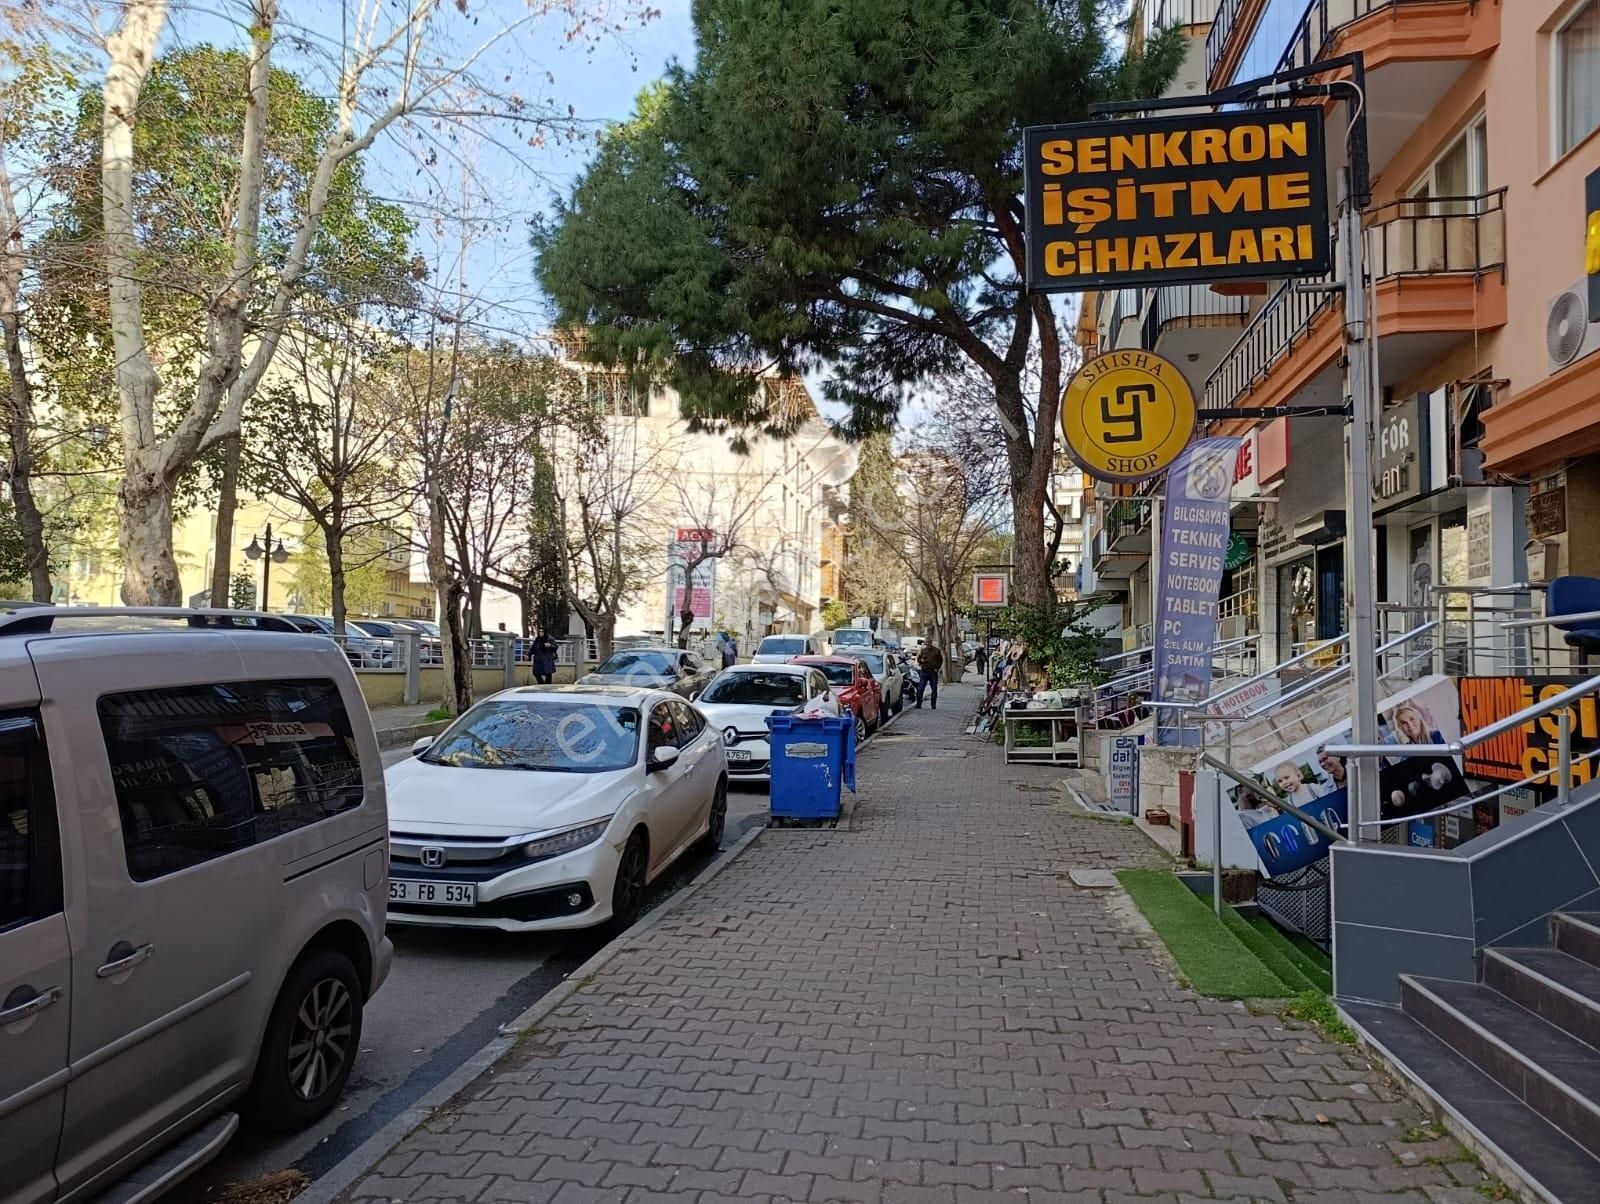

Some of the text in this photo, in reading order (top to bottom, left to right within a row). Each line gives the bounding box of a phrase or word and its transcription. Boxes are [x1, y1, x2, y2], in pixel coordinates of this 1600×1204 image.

[1040, 121, 1308, 176] SENKRON
[1042, 172, 1311, 234] İŞİTME
[1044, 224, 1313, 277] CİHAZLARI
[1083, 353, 1162, 383] SHISHA
[1106, 453, 1158, 473] SHOP
[1172, 528, 1224, 549] TEKNİK
[1169, 551, 1221, 571] SERVİS
[1167, 574, 1219, 593] NOTEBOOK
[1166, 596, 1216, 616] TABLET
[1163, 619, 1182, 636] PC
[389, 882, 472, 902] 53 FB 534
